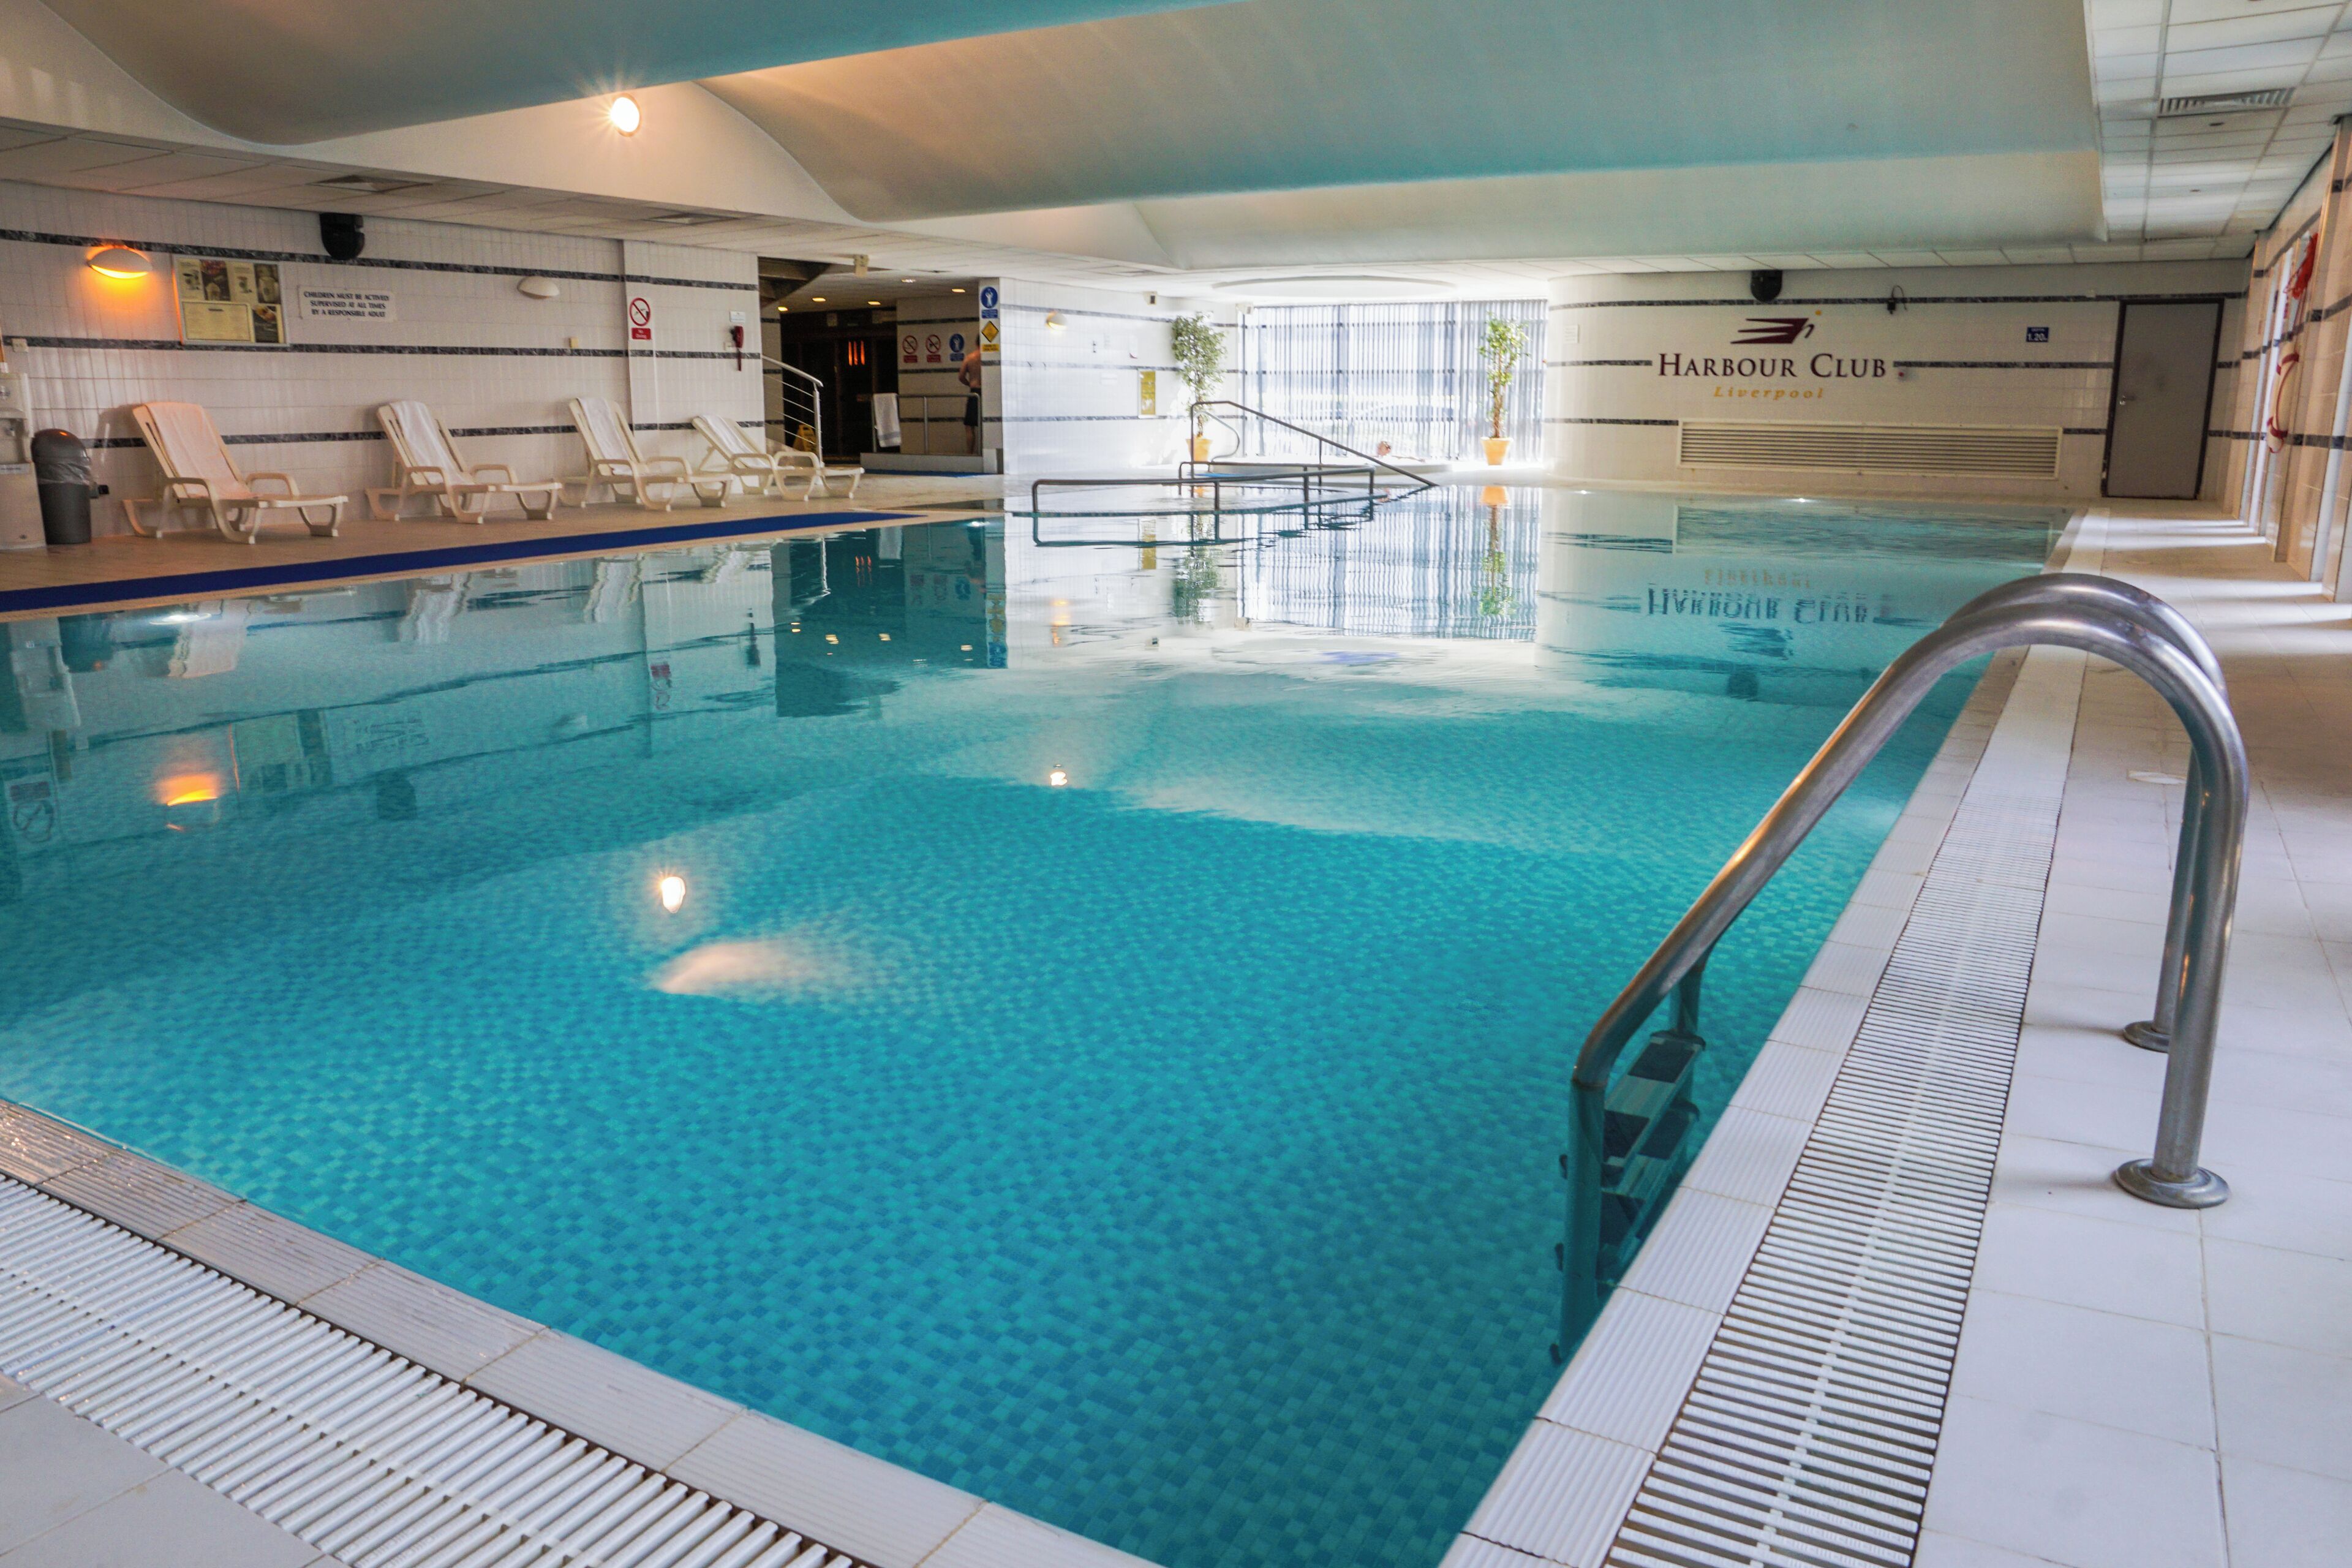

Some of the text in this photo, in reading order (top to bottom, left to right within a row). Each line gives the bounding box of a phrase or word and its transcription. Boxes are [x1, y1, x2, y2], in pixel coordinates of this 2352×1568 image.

[1658, 353, 1887, 378] HARBOUR CLUB
[1713, 386, 1824, 401] Liverpool
